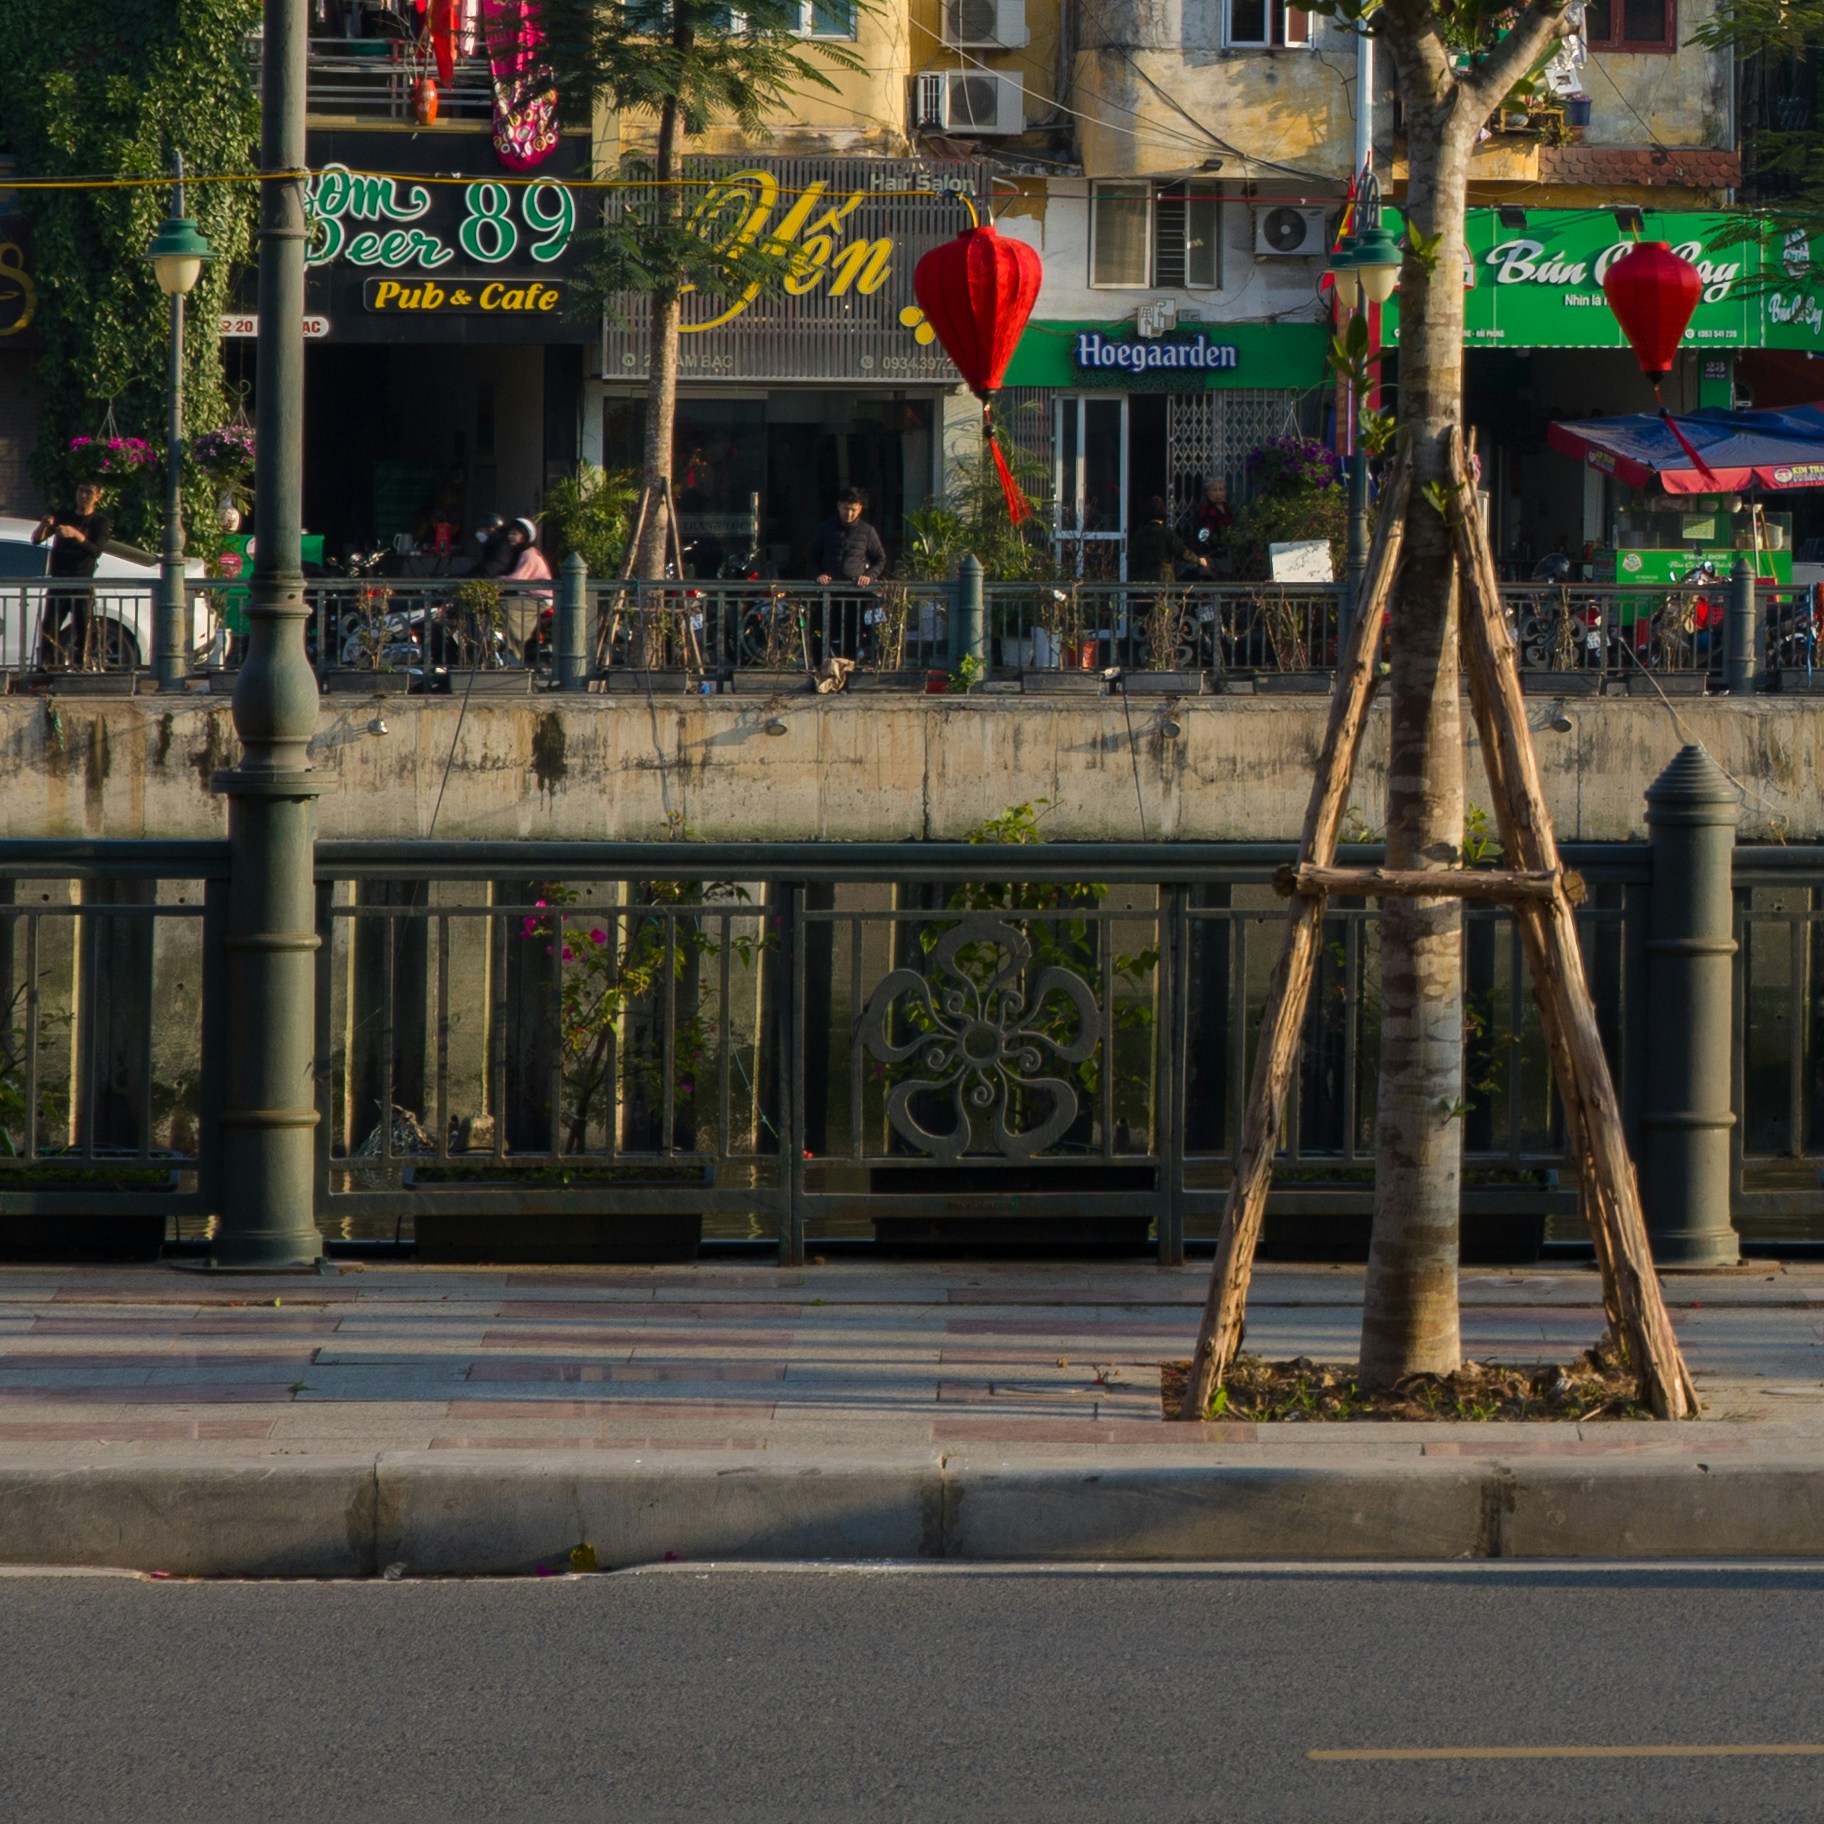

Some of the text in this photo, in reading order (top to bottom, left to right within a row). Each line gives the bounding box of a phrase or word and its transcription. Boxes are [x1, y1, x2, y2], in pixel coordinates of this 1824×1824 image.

[870, 174, 974, 192] Hair Salon
[460, 177, 575, 263] 89
[1486, 239, 1588, 285] Bún
[375, 281, 559, 311] Pub & Cafe
[235, 320, 321, 335] 20 ẠC
[1077, 333, 1237, 372] Hoegaarden
